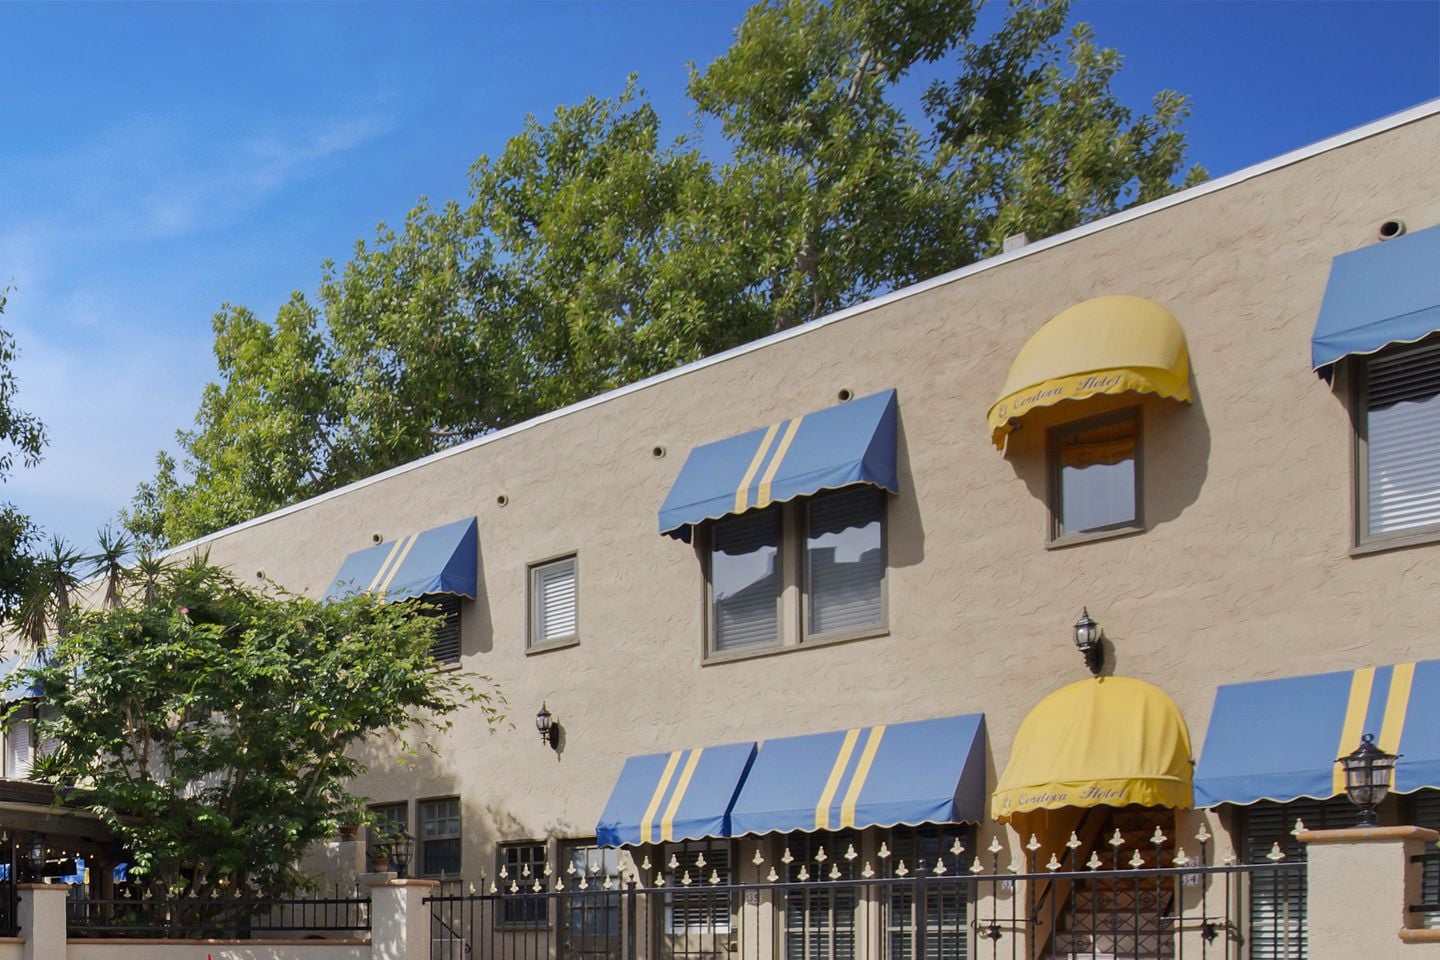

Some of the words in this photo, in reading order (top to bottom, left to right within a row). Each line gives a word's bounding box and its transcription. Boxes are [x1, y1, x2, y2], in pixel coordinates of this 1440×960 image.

[1013, 387, 1063, 409] Cordova
[1076, 375, 1121, 391] Hotel
[1018, 793, 1067, 806] Cordova
[1080, 786, 1128, 800] Hotel
